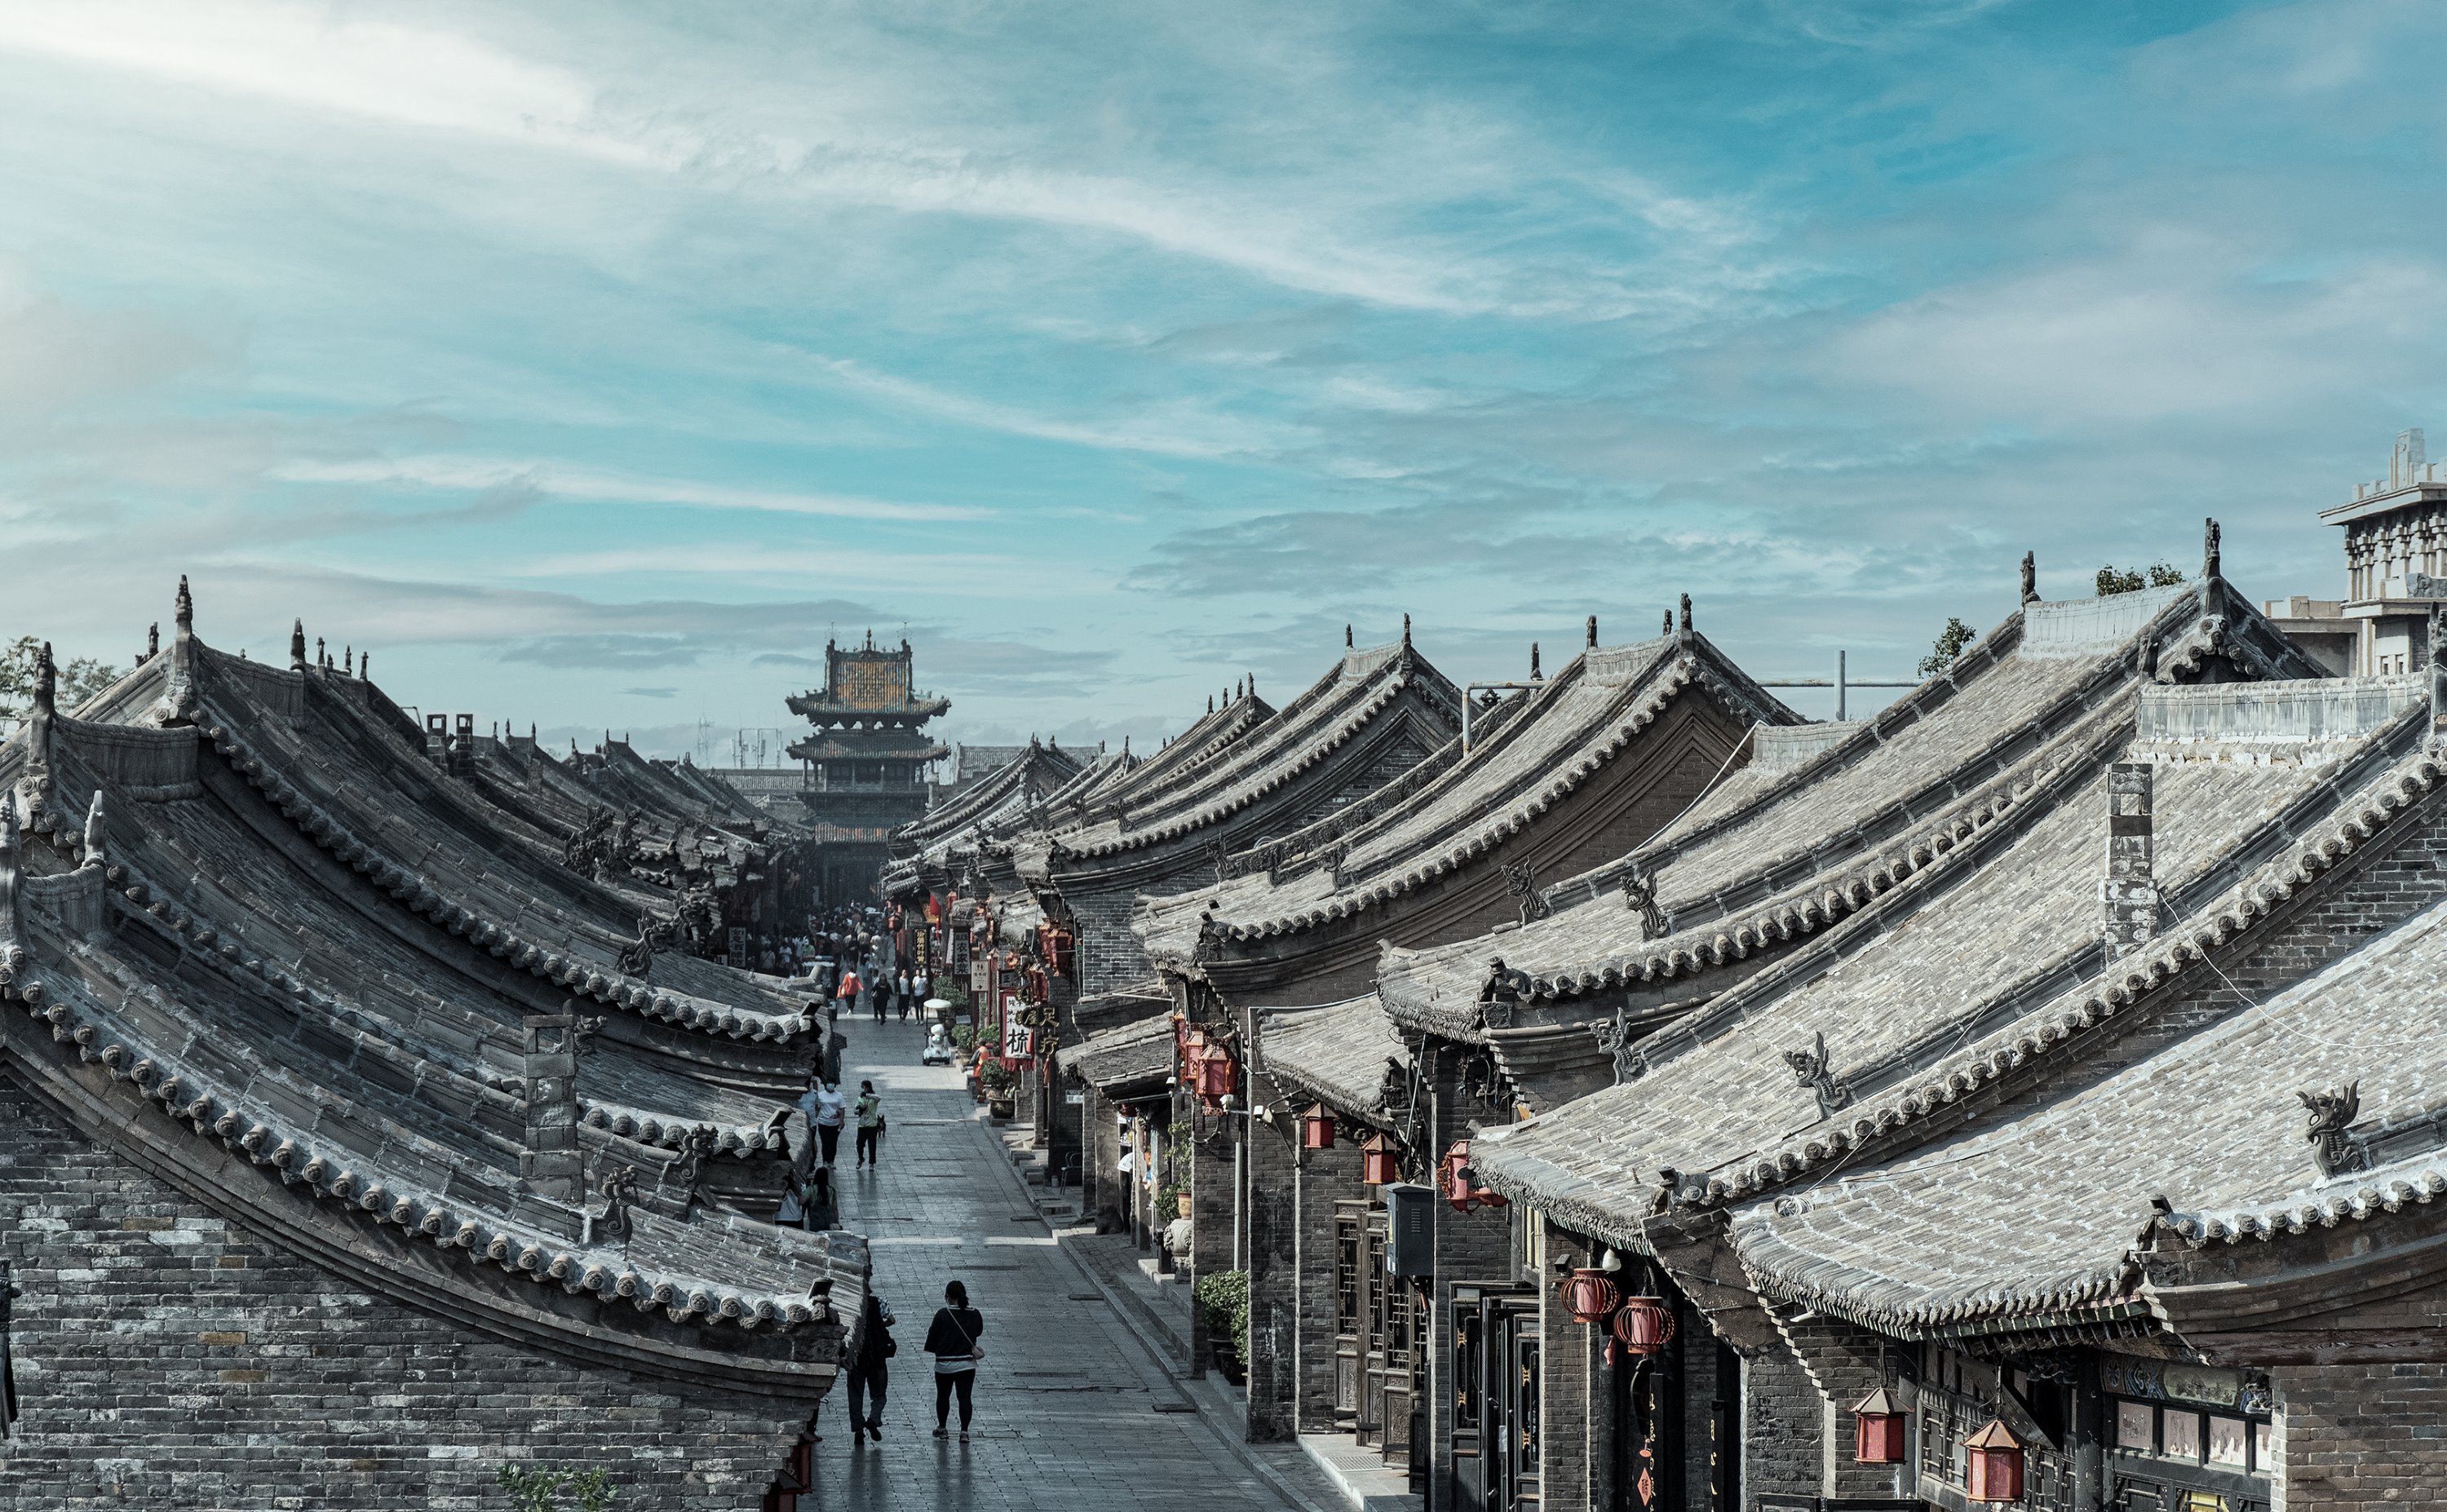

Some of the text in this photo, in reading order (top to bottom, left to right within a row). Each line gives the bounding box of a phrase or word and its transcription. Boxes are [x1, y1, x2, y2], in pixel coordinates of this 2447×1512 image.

[956, 942, 969, 974] 农家菜
[1007, 1028, 1031, 1054] 梳
[1038, 1007, 1060, 1055] 足疗
